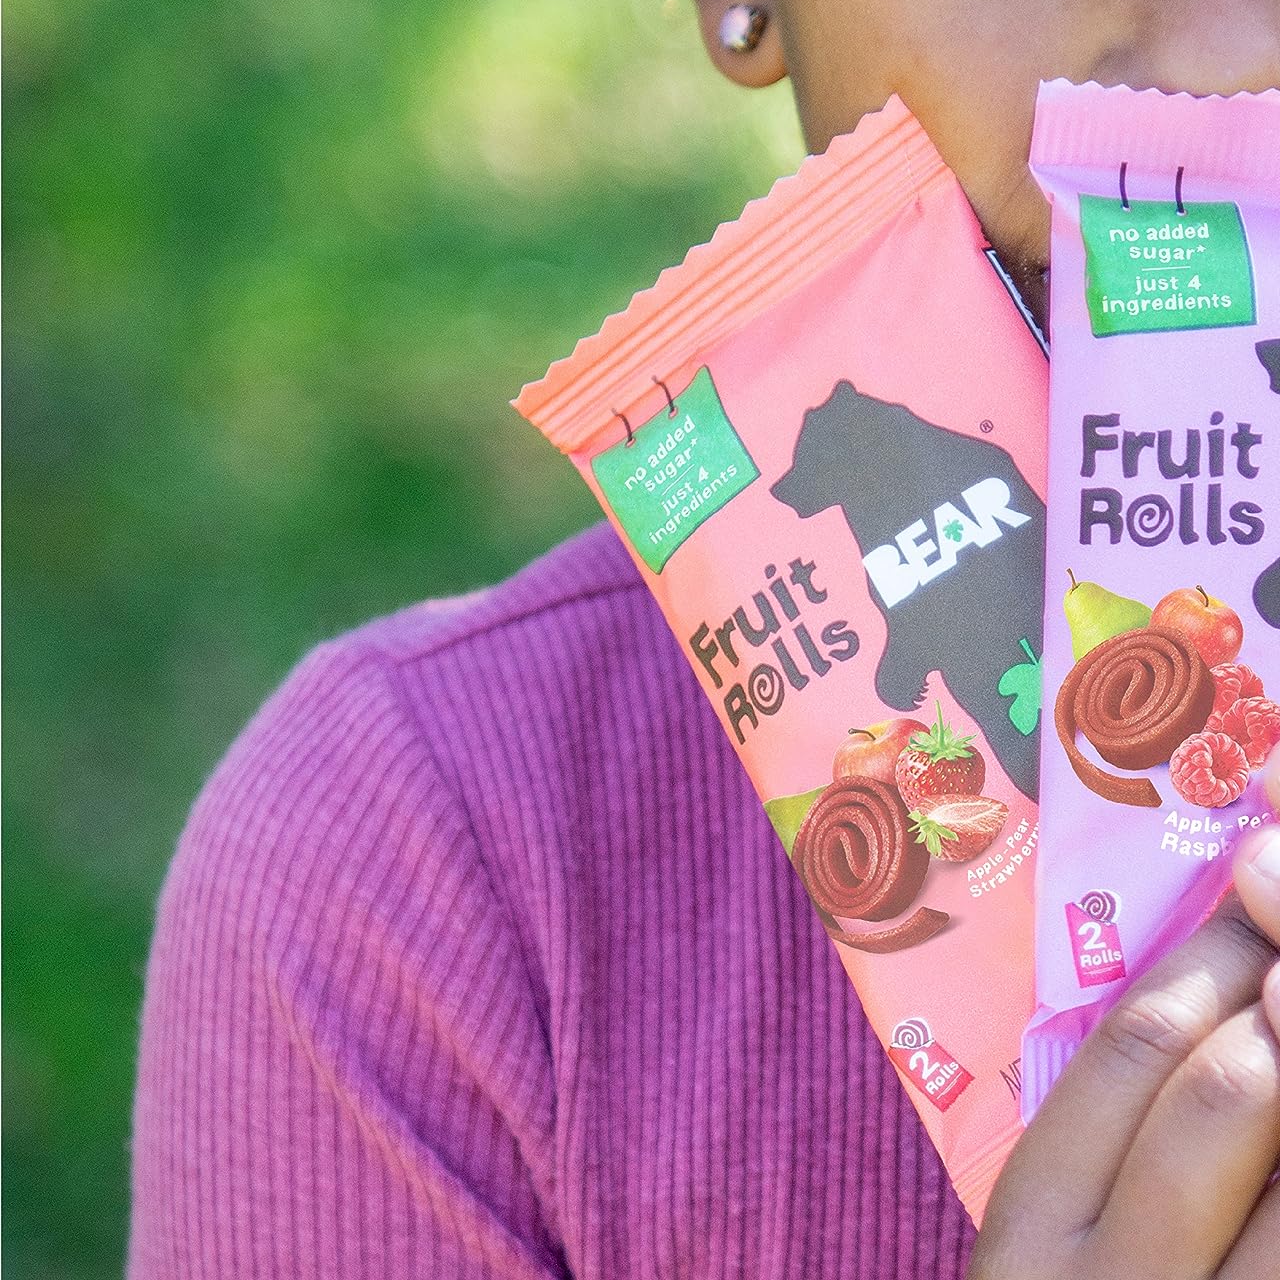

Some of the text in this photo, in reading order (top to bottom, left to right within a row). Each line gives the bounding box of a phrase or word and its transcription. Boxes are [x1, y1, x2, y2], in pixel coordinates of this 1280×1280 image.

[1109, 223, 1209, 242] no added
[1102, 293, 1232, 316] ingredients
[1135, 275, 1202, 295] just 4
[624, 414, 695, 491] no added
[1080, 411, 1263, 478] Fruit
[648, 463, 737, 545] ingredients
[661, 465, 710, 516] just 4
[1078, 483, 1265, 547] Rolls
[862, 477, 1033, 609] BEAR
[689, 557, 828, 689] Fruit
[723, 620, 860, 745] Rolls
[1078, 921, 1107, 951] 2
[1080, 949, 1122, 967] Rolls
[909, 1051, 940, 1081] 2
[925, 1061, 959, 1095] Rolls
